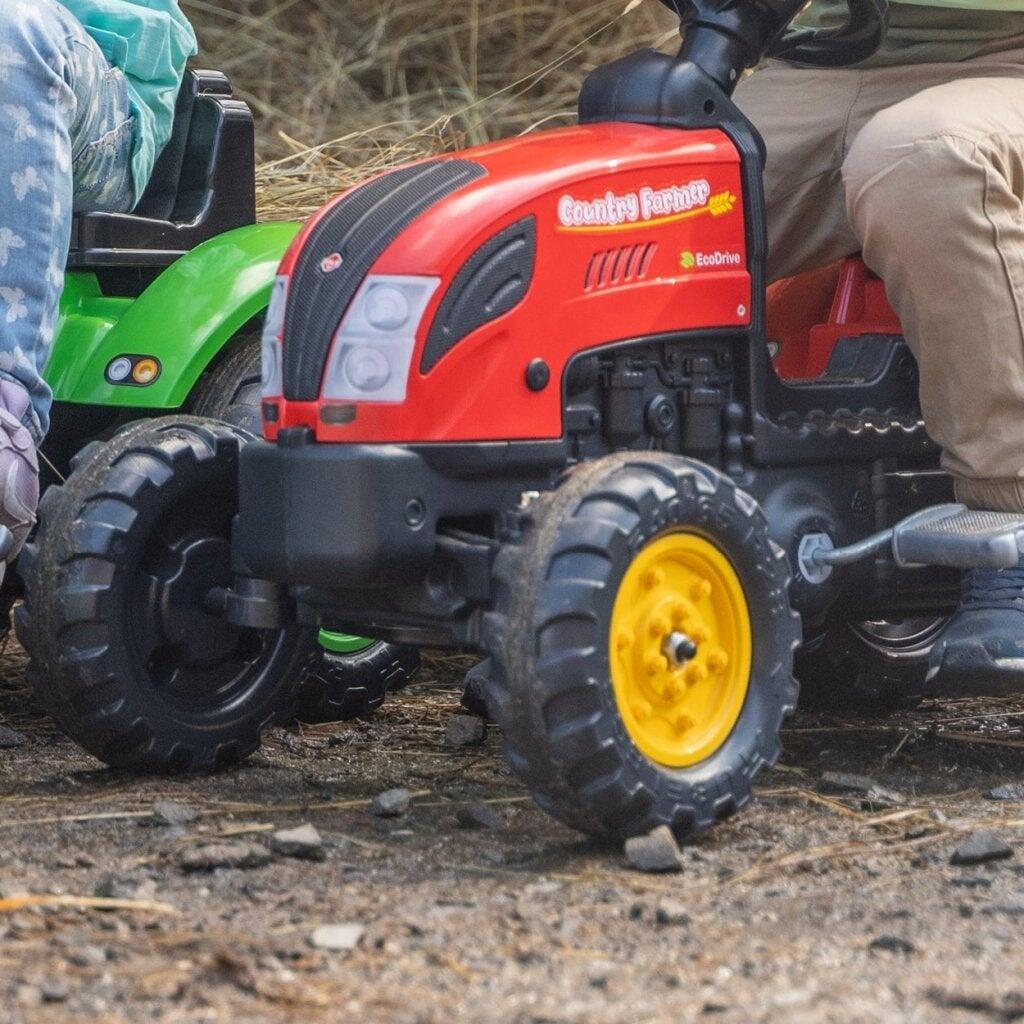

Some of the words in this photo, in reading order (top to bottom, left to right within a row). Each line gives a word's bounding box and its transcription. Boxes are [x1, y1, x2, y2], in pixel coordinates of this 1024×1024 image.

[558, 192, 639, 226] Country
[639, 179, 710, 219] Farmer
[696, 252, 740, 266] EcoDrive
